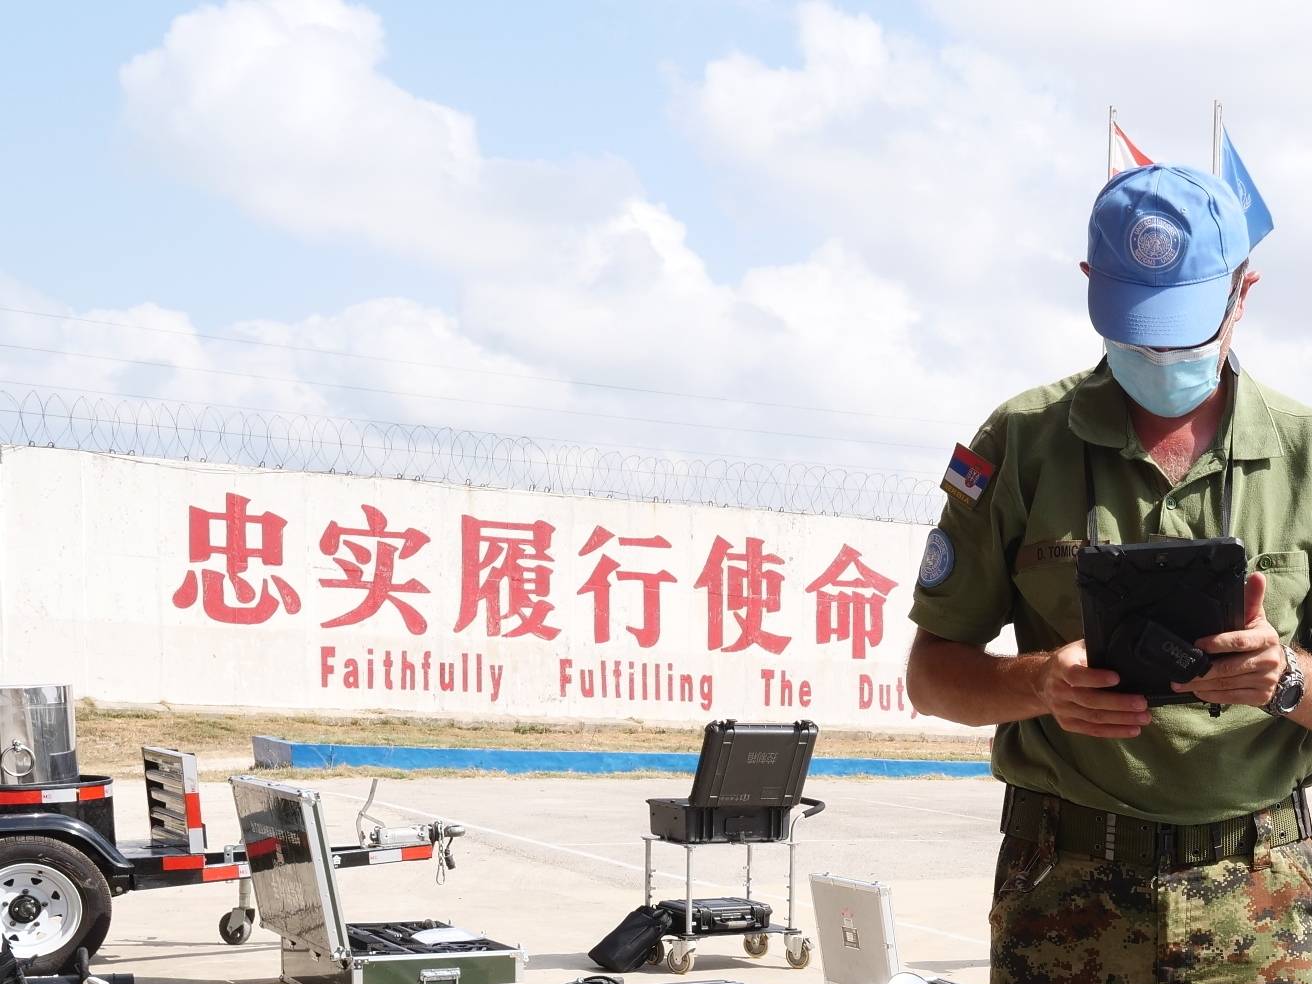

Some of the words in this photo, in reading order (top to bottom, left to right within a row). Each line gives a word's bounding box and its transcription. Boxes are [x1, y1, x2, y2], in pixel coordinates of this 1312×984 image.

[172, 491, 898, 660] 忠实履行使命
[320, 646, 504, 702] Faithfully
[559, 658, 713, 711] Fulfilling
[761, 668, 812, 707] The
